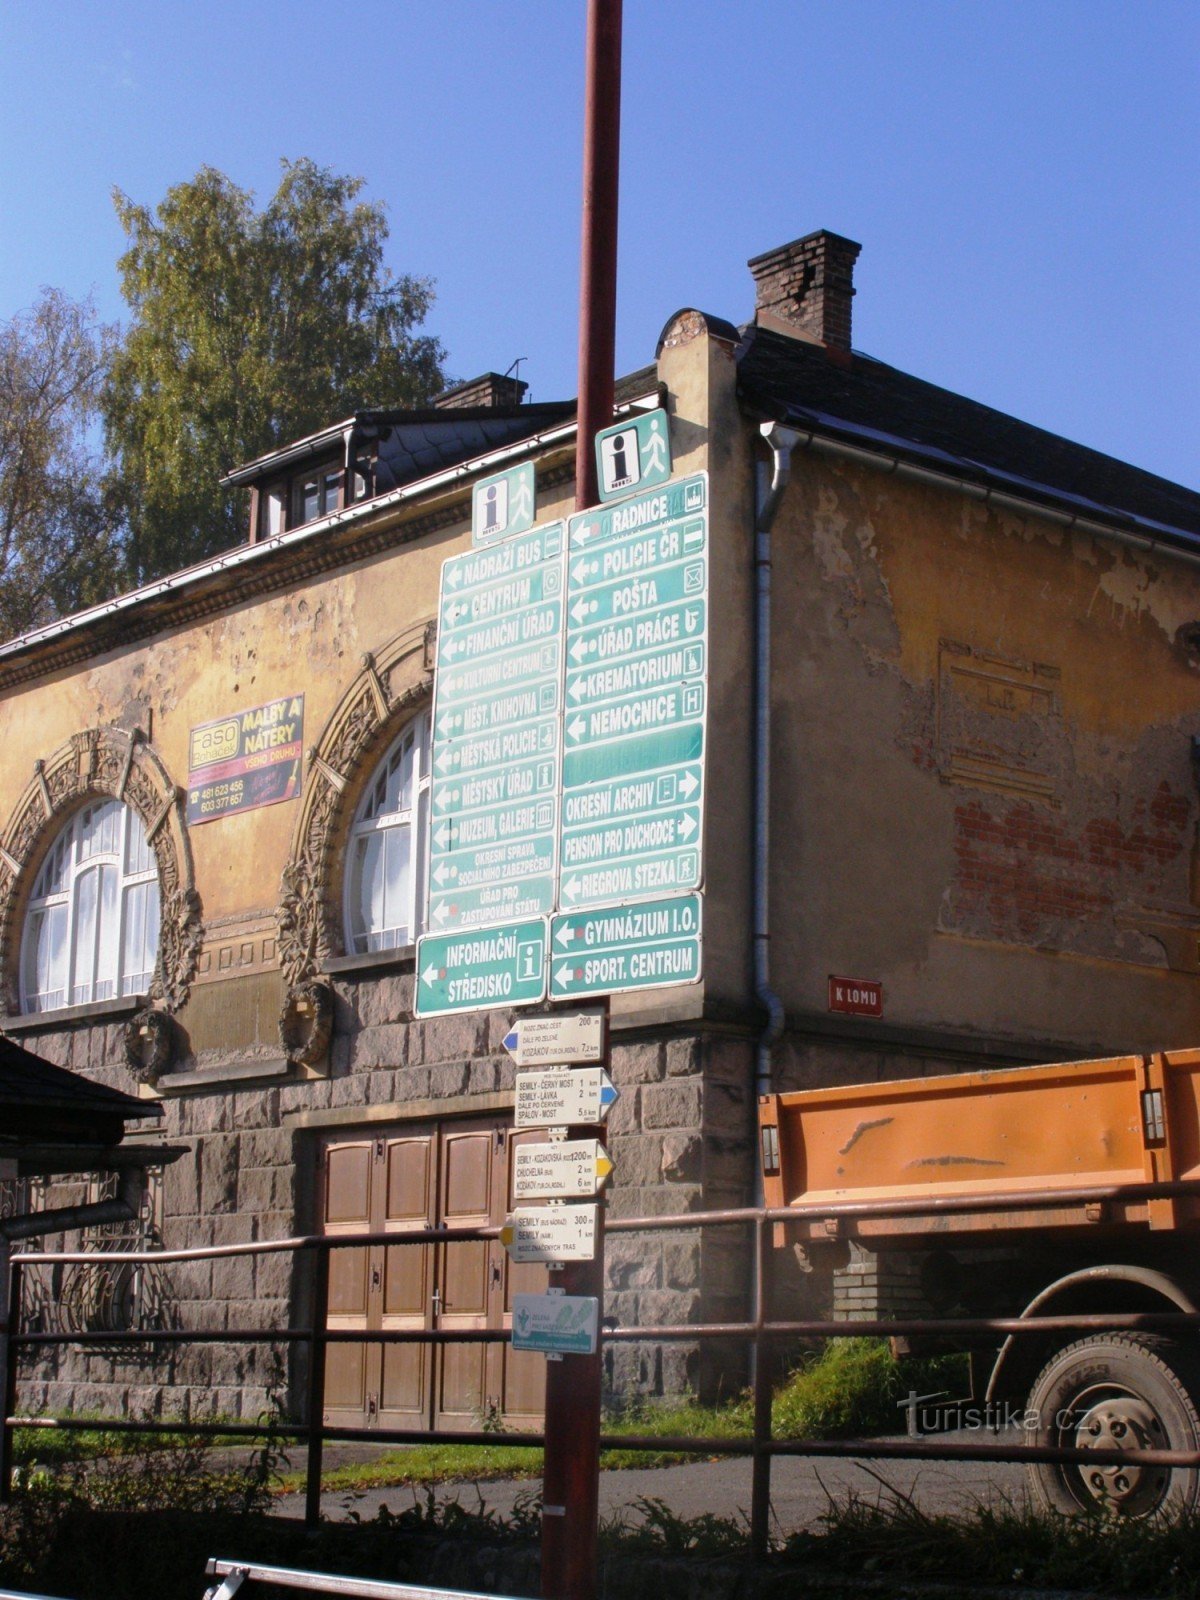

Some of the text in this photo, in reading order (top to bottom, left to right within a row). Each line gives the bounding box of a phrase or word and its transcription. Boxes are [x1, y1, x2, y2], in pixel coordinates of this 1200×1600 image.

[612, 496, 668, 532] RADNICE
[464, 541, 541, 586] NÁDRAŽÍ BUS
[603, 527, 679, 575] POLICIE ČR
[471, 577, 530, 616] CENTRUM
[612, 572, 658, 613] POŠTA
[466, 607, 554, 657] FINANČNÍ ÚŘAD
[598, 613, 680, 657] ÚŘAD PRÁCE
[502, 655, 541, 681] CENTRUM
[586, 652, 682, 698] KREMATORIUM
[242, 698, 300, 733] MALBY A
[464, 691, 536, 730] MĚST. KNIHOVNA
[590, 693, 676, 736] NEMOCNICE
[245, 722, 295, 755] NÁTĚRY
[270, 747, 296, 762] DRUHU
[460, 729, 537, 767] MĚSTSKÁ POLICIE
[201, 786, 215, 800] 481
[215, 783, 229, 797] 623
[461, 777, 503, 804] MĚSTSKÝ
[506, 770, 534, 795] ÚŘAD
[566, 783, 655, 822] OKRESNÍ ARCHIV
[459, 807, 536, 843] MUZEUM, GALERIE
[474, 847, 506, 867] OKRESNÍ
[565, 833, 603, 862] PENSION
[604, 830, 622, 854] PRO
[458, 861, 500, 887] SOCIÁLNÍHO
[581, 860, 675, 899] RIEGROVA STEZKA
[461, 896, 540, 925] ZASTUPOVÁNÍ STÁTU
[480, 884, 519, 905] ÚŘAD PRO
[585, 906, 696, 946] GYMNÁZIUM I.O.
[447, 929, 518, 968] INFORMAČNÍ
[585, 947, 692, 985] SPORT. CENTRUM
[448, 968, 512, 1003] STŘEDISKO
[836, 987, 877, 1006] K LOMU
[578, 1016, 592, 1027] 200
[519, 1081, 537, 1090] SEMILY
[559, 1079, 574, 1088] MOST
[519, 1092, 537, 1102] SEMILY
[579, 1089, 584, 1098] 2
[542, 1109, 557, 1118] MOST
[577, 1165, 583, 1174] 2
[577, 1177, 583, 1187] 6
[518, 1230, 539, 1240] SEMILY
[519, 1217, 539, 1227] SEMILY
[574, 1215, 588, 1225] 300
[563, 1243, 576, 1251] TRAS
